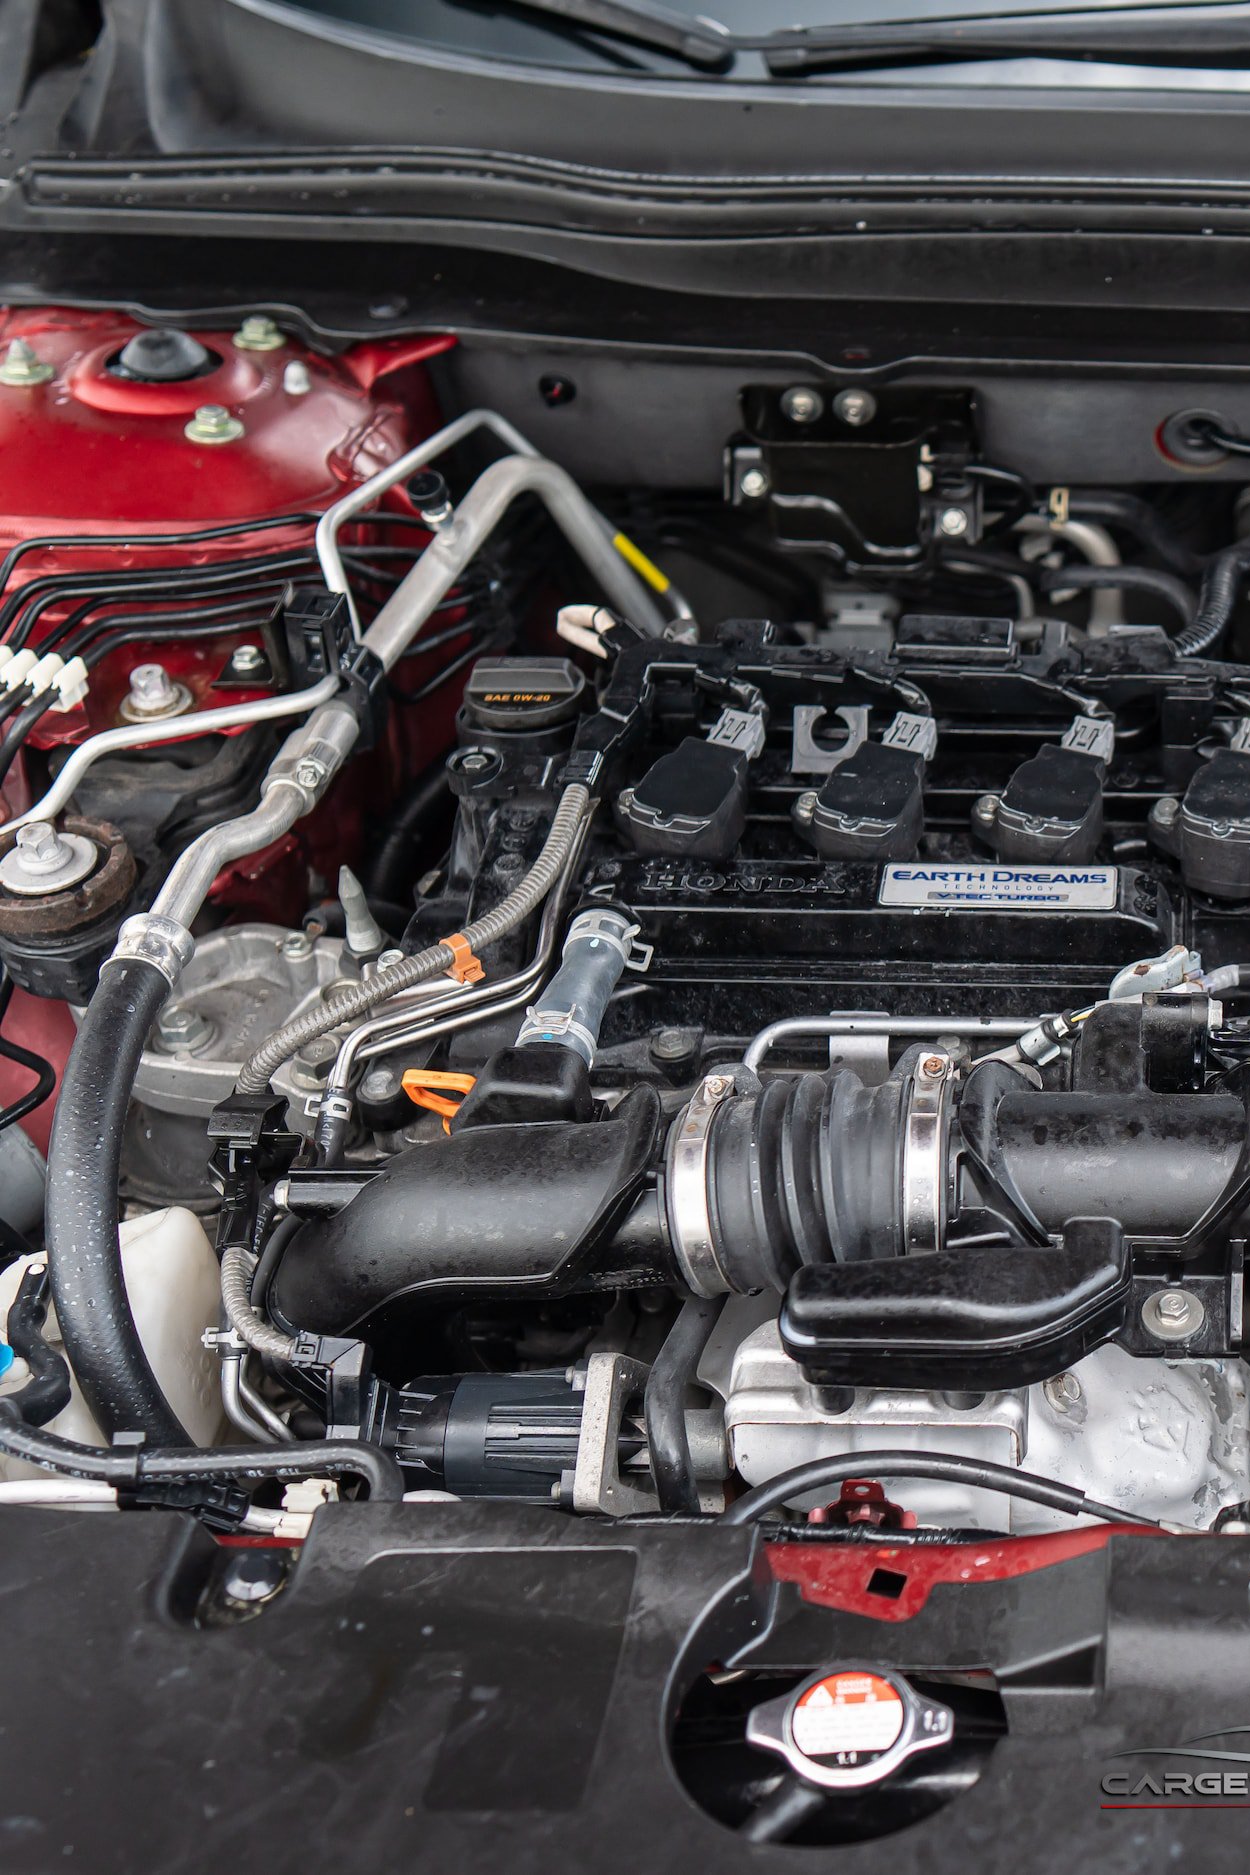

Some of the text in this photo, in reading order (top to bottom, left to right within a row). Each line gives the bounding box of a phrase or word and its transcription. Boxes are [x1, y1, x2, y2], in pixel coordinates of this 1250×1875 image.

[641, 873, 846, 894] HONDA
[892, 870, 1108, 884] EARTH DREAMS
[994, 893, 1061, 901] TURBO
